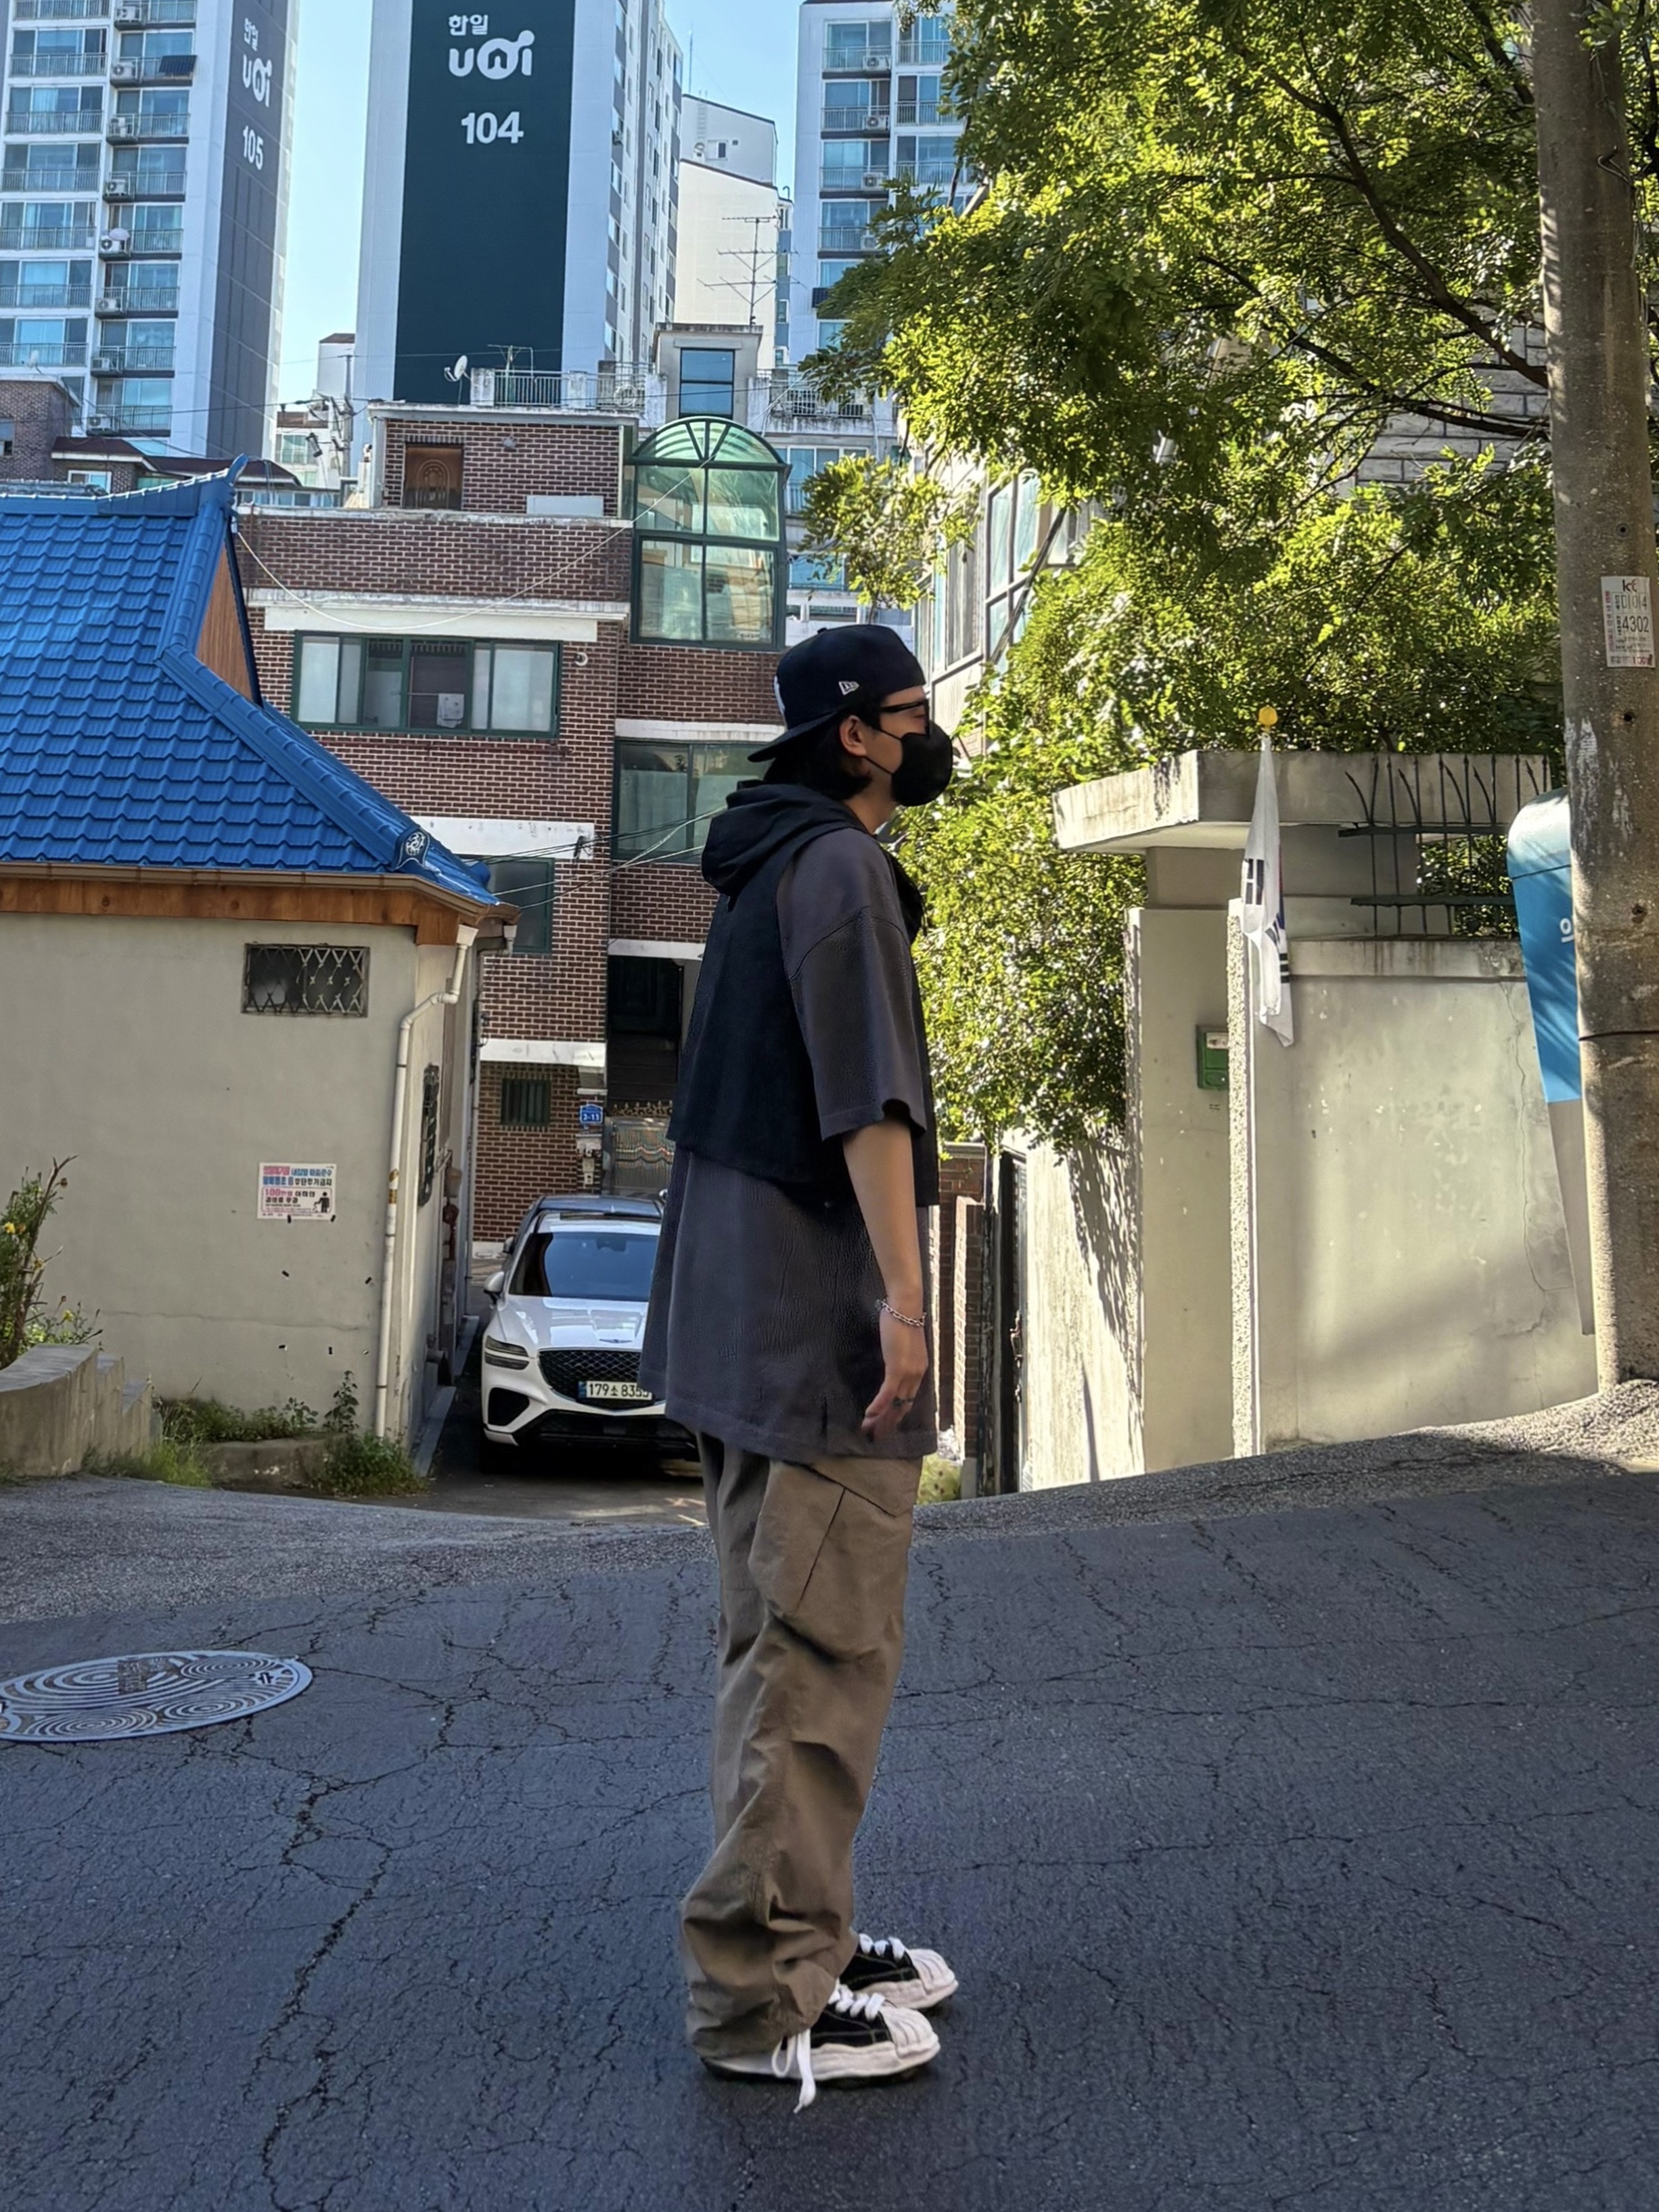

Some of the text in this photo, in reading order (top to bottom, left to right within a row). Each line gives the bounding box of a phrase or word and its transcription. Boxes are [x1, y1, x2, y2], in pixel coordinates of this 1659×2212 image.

[449, 14, 488, 35] 한일
[461, 111, 524, 144] 104
[243, 125, 264, 171] 105
[1622, 615, 1650, 633] 4302
